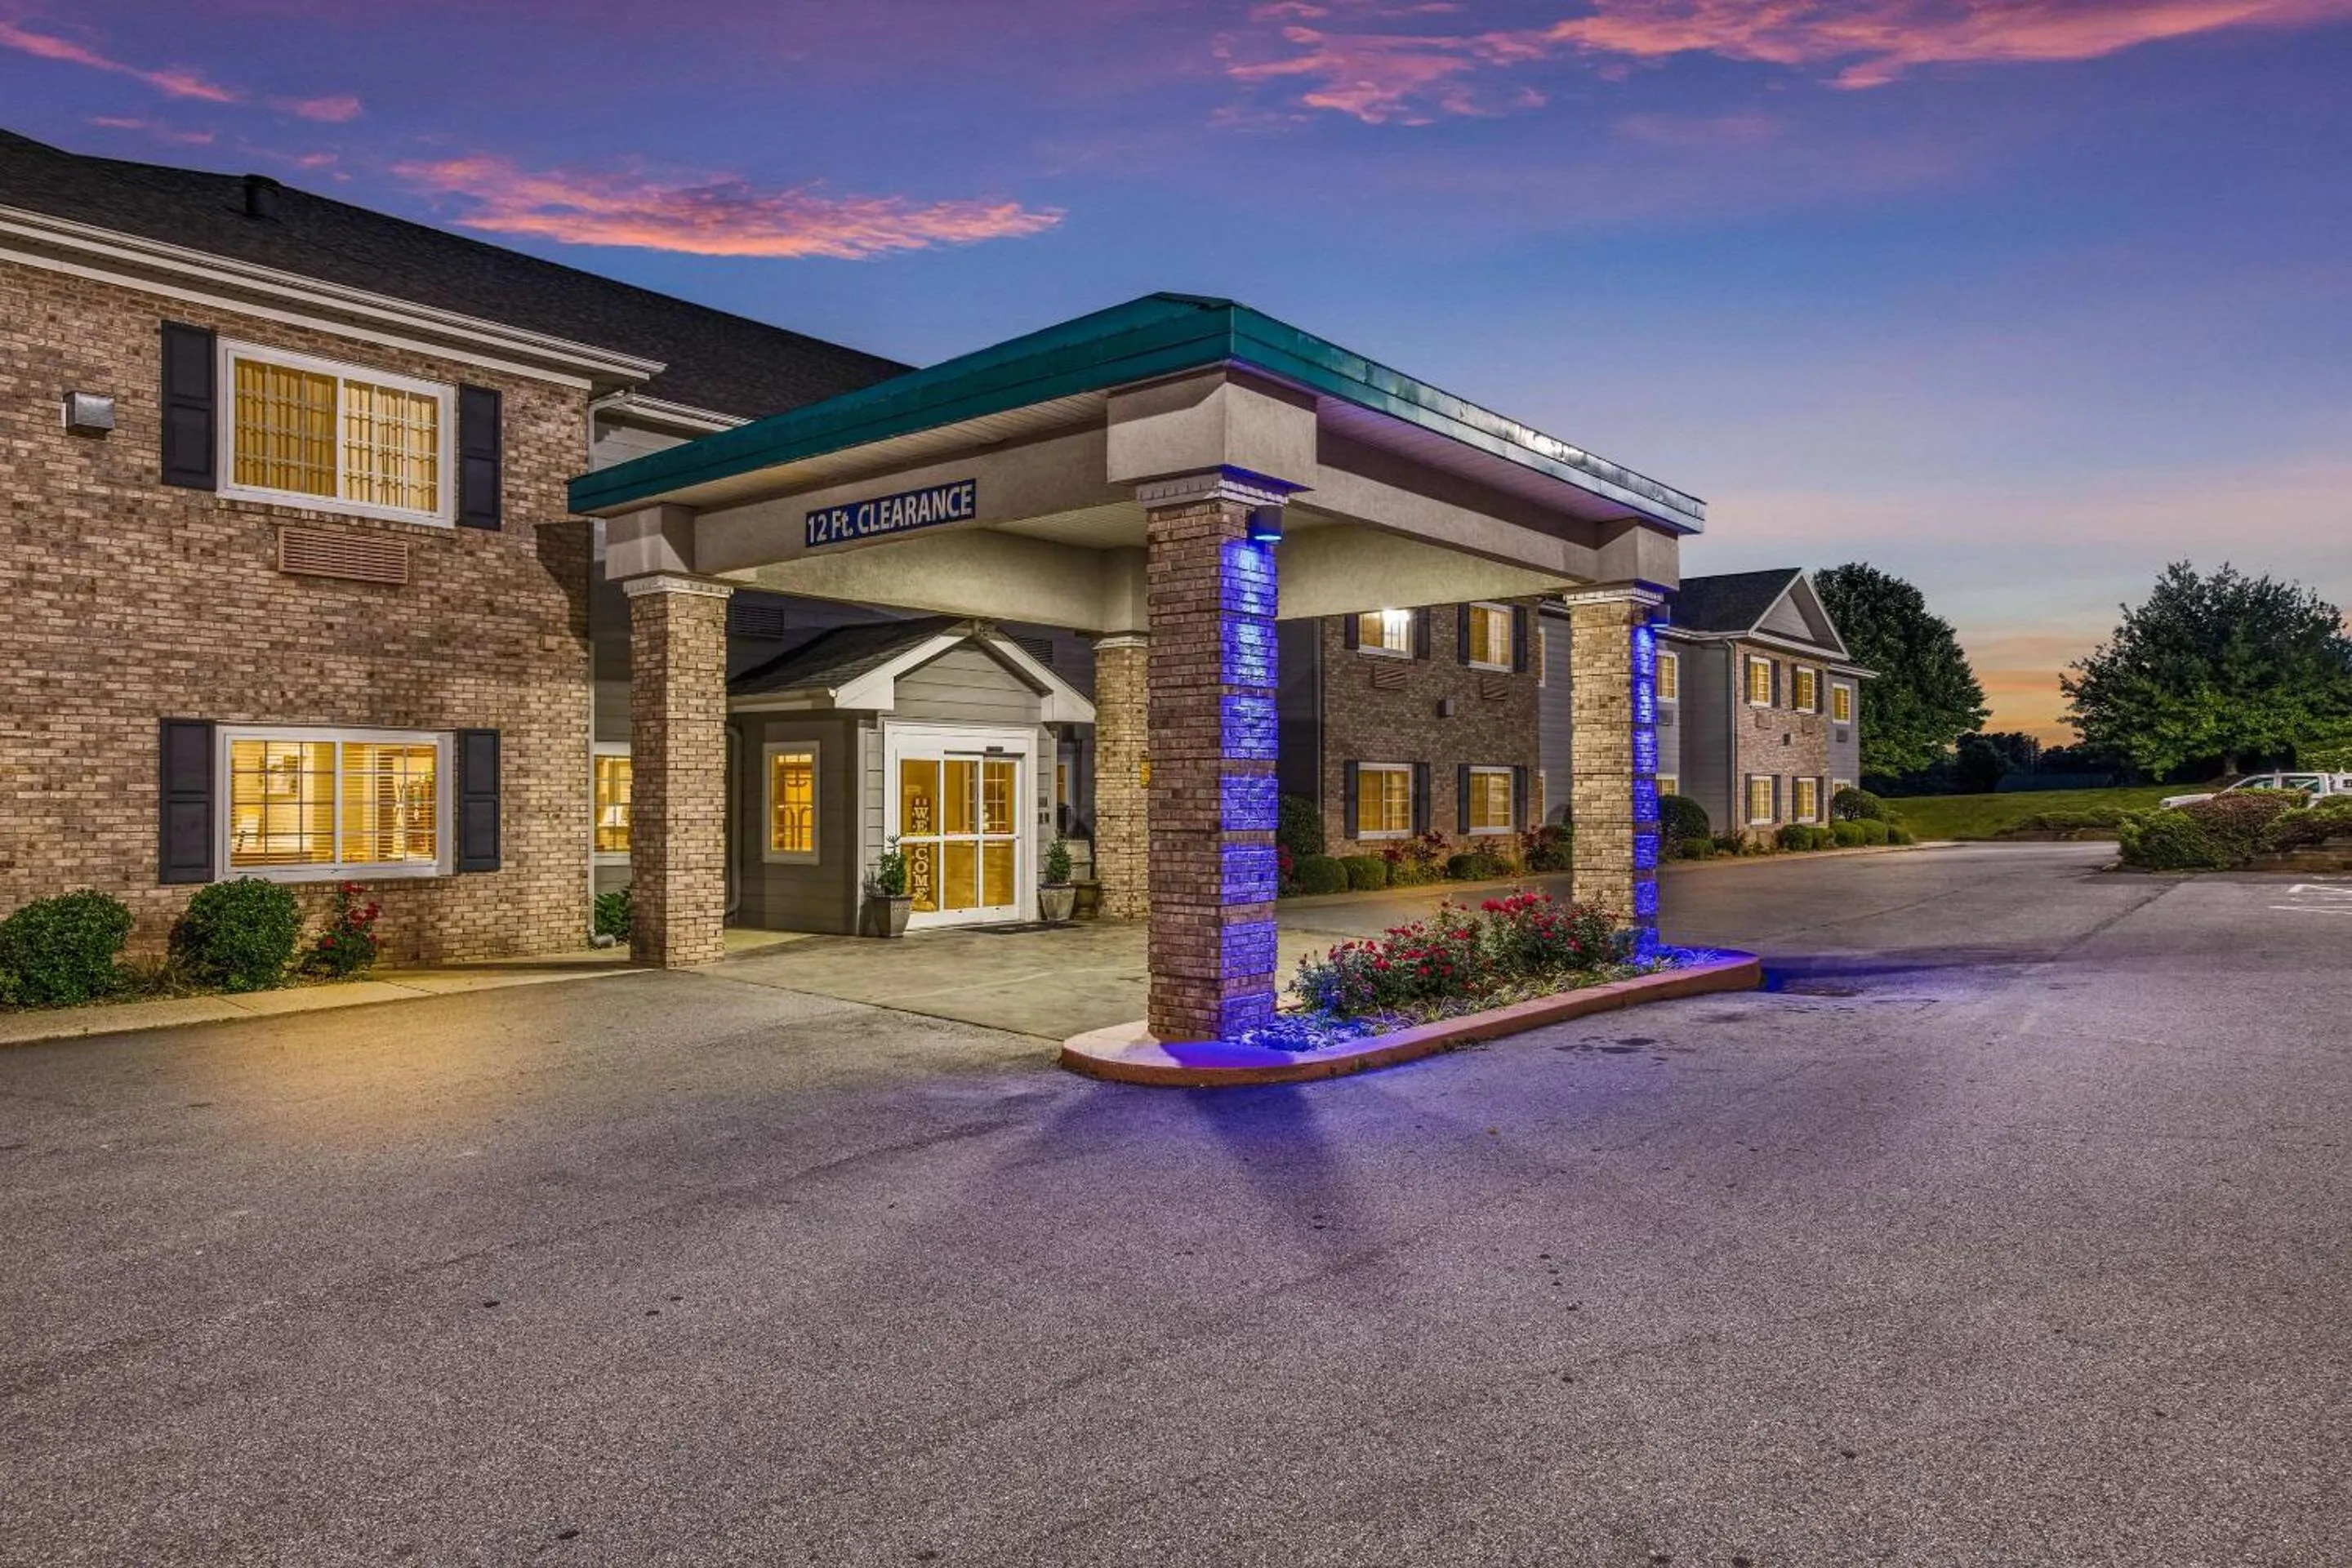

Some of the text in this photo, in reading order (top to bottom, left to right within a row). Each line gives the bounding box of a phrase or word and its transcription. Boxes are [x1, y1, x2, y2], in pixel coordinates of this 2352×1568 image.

[808, 484, 973, 543] 12 Ft. CLEARANCE
[914, 806, 929, 901] WECOME
